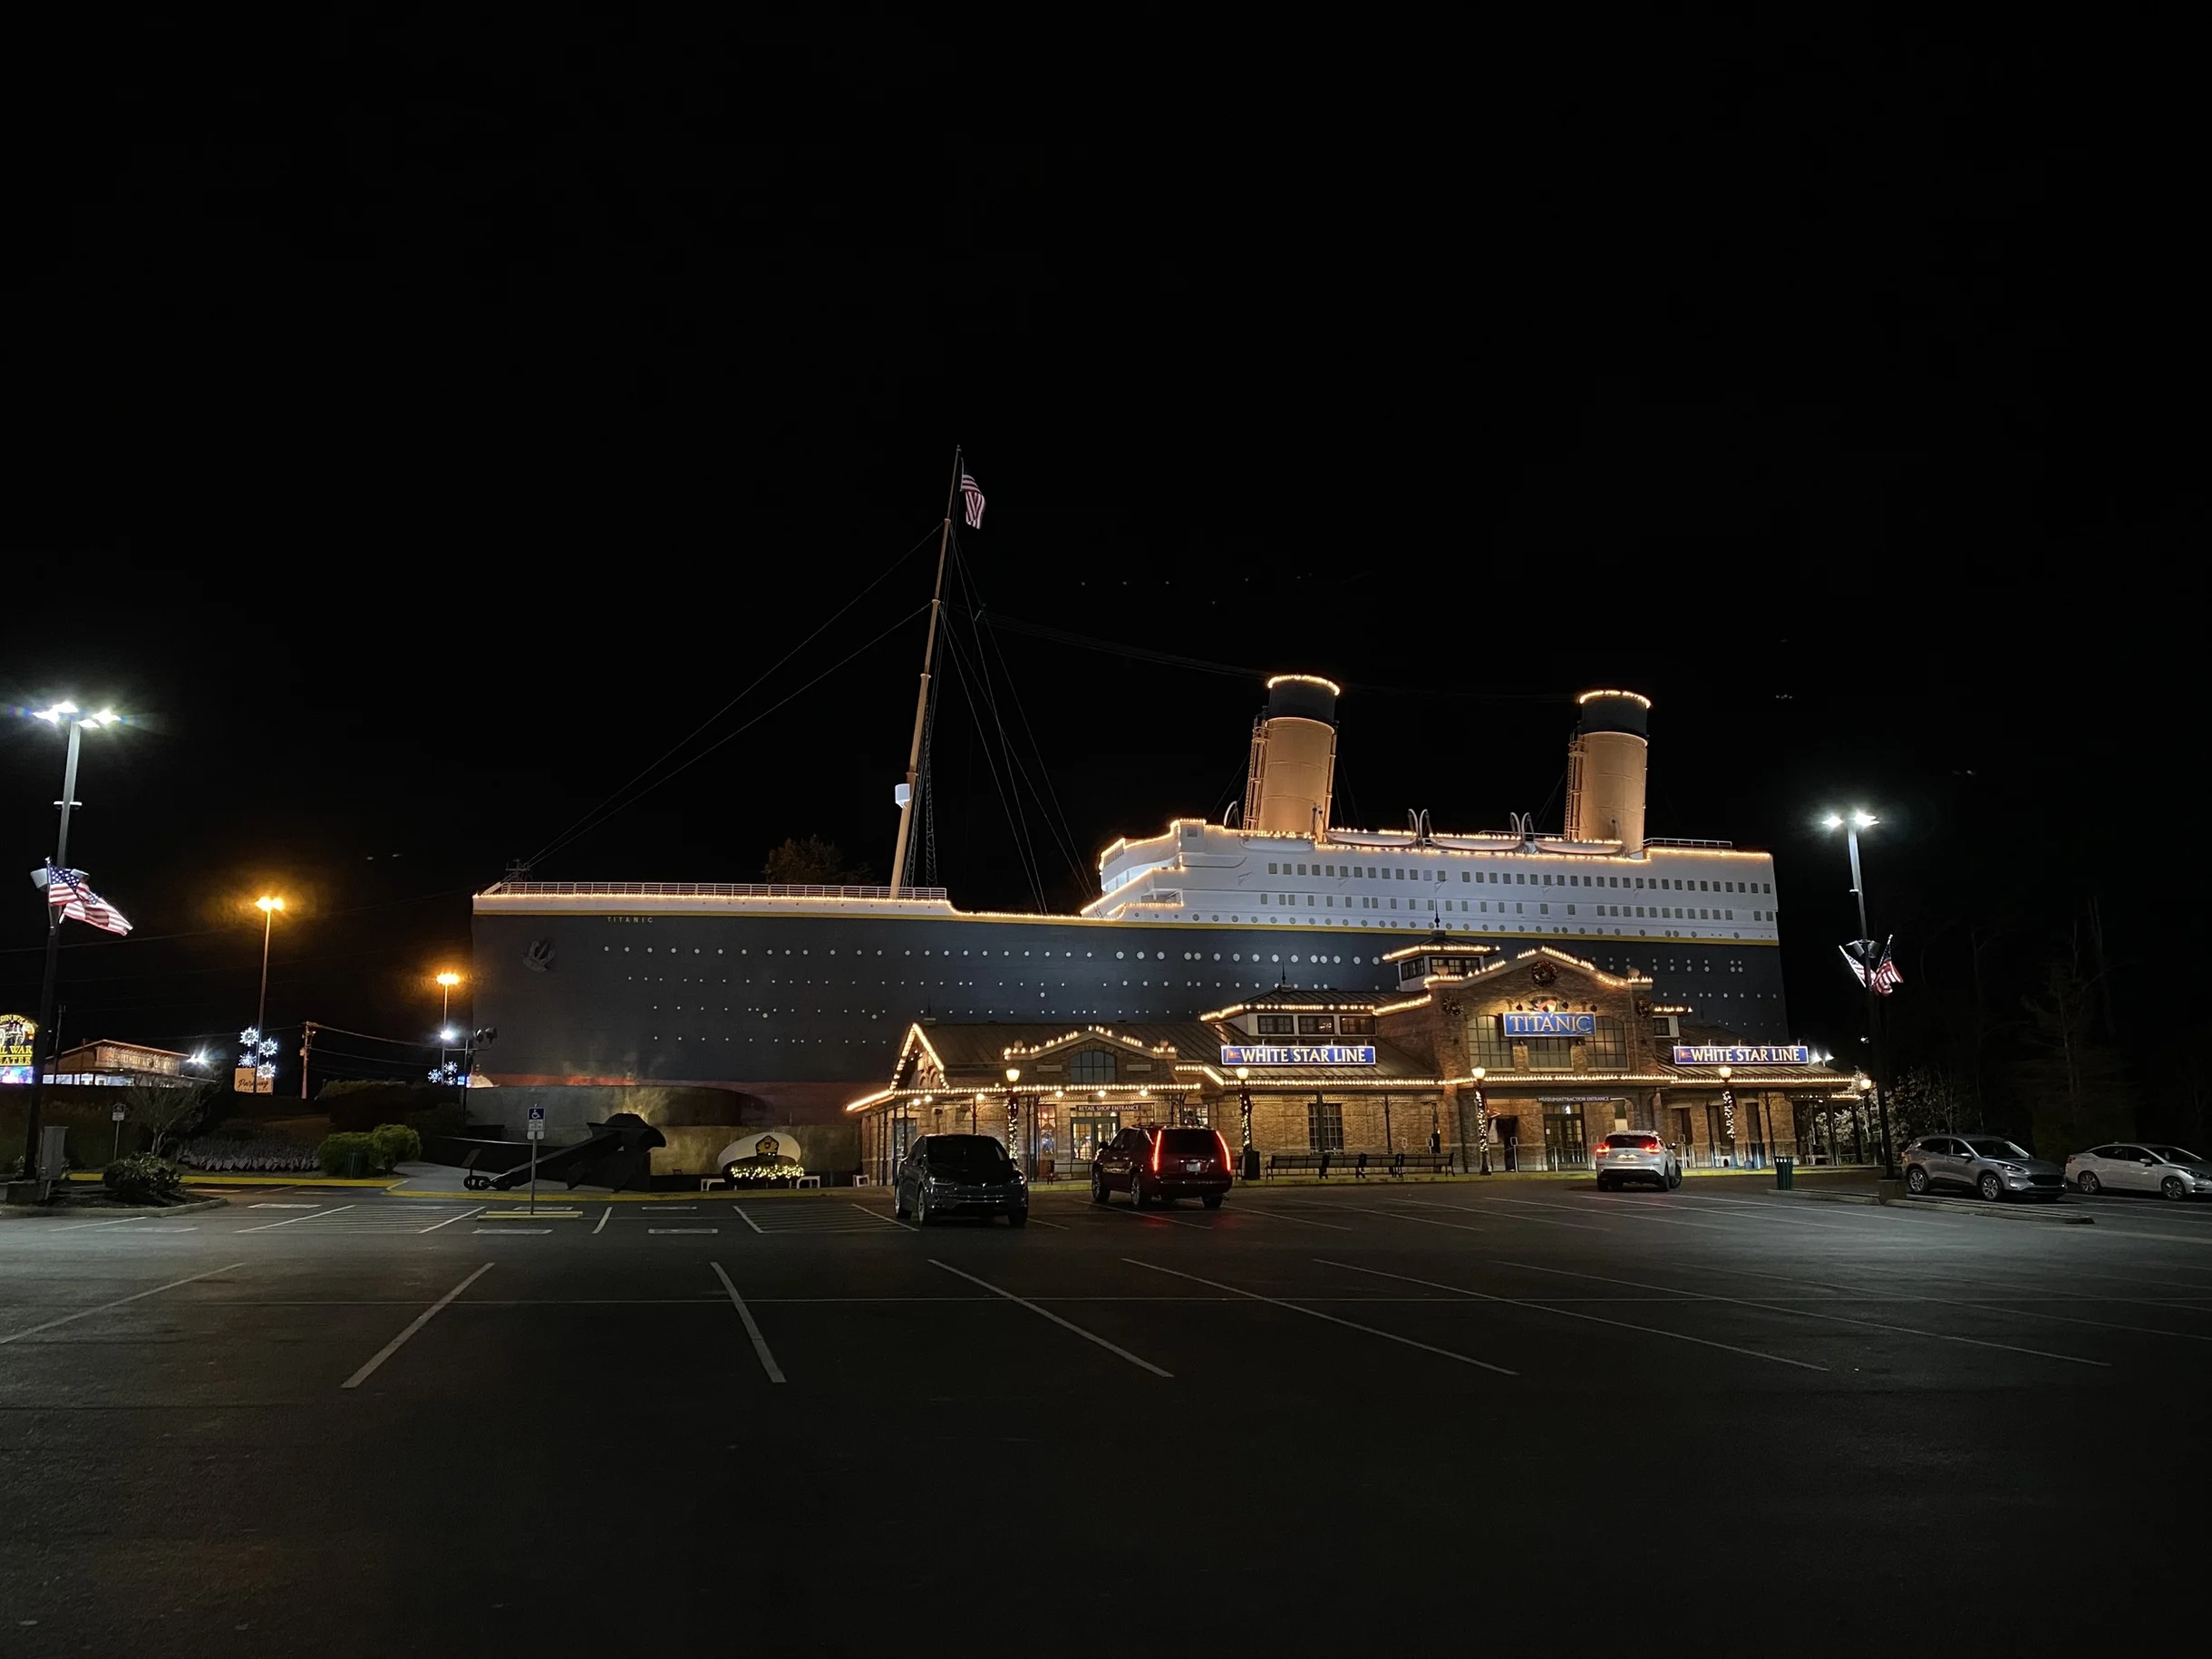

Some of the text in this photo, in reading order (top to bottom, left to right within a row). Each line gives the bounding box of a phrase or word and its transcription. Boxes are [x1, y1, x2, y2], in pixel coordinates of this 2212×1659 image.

[1509, 1015, 1591, 1033] TITANIC
[9, 1045, 33, 1054] WAR
[1240, 1048, 1366, 1062] WHITE STAR LINE
[1690, 1048, 1800, 1062] WHITE STAR LINE
